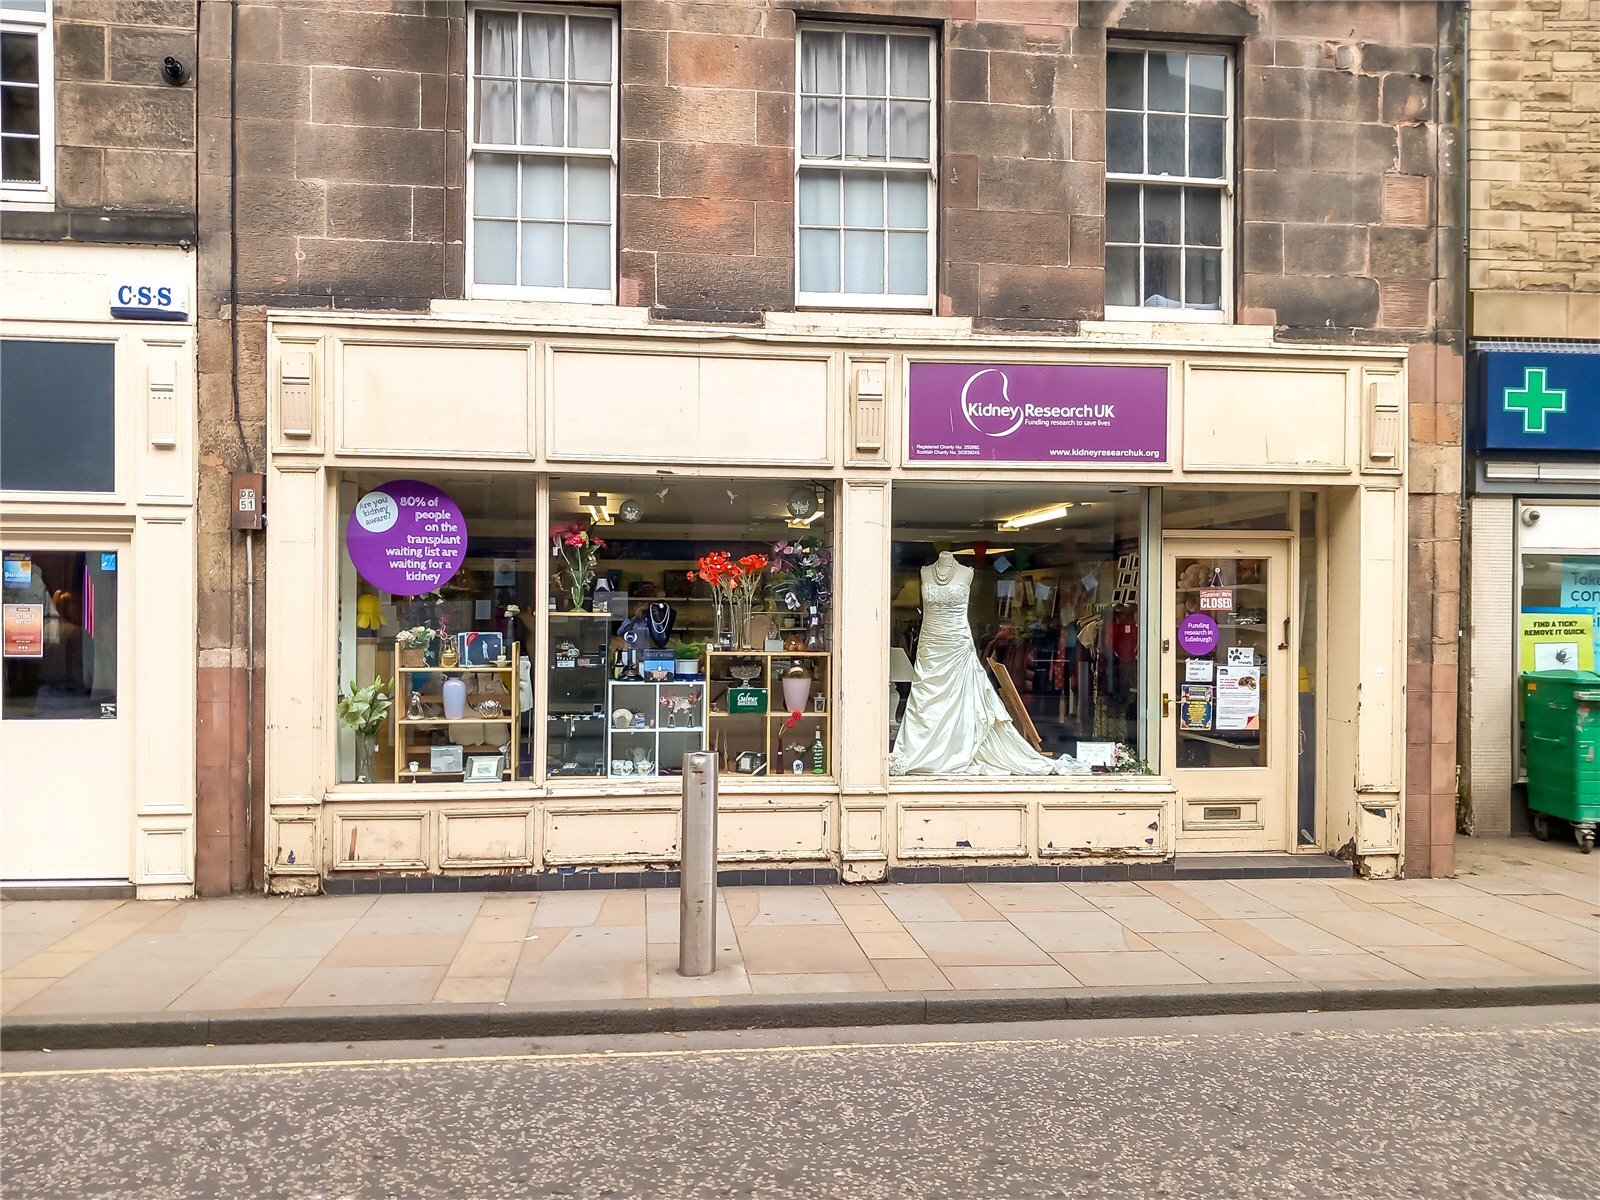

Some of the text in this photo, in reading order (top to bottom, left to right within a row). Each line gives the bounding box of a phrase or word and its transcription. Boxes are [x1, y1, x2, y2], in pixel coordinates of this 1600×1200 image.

[968, 402, 1115, 420] Kidney Research UK
[1025, 419, 1049, 427] Funding
[1049, 448, 1160, 458] www.kidneyresearchuk.org
[240, 500, 253, 510] 51
[359, 496, 388, 510] Are you
[400, 496, 440, 507] 80% of
[362, 505, 389, 518] kidney
[415, 509, 451, 522] people
[365, 512, 392, 526] aware?
[424, 521, 458, 532] on the
[407, 534, 461, 547] transplant
[385, 546, 458, 558] waiting list are
[389, 558, 452, 570] waiting for a
[405, 571, 440, 584] kidney
[1200, 597, 1232, 608] CLOSED
[1187, 622, 1210, 630] Funding
[1557, 620, 1578, 628] TICK?
